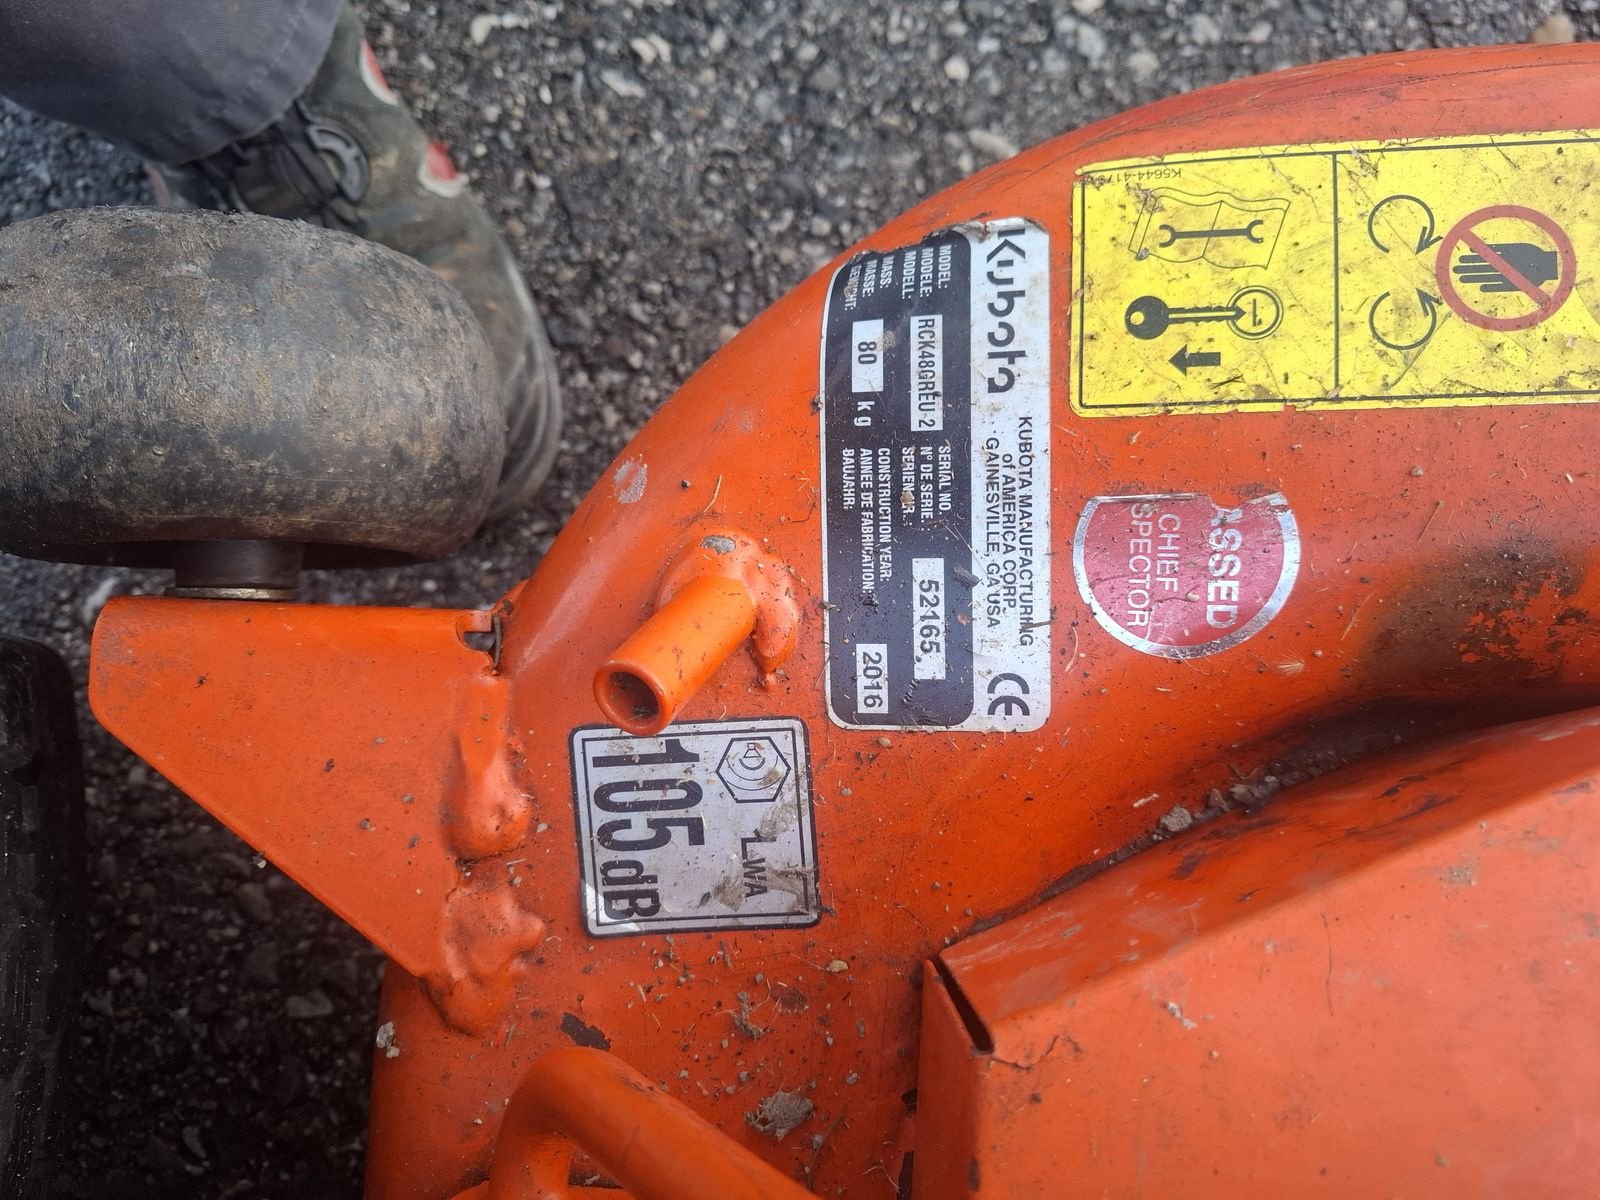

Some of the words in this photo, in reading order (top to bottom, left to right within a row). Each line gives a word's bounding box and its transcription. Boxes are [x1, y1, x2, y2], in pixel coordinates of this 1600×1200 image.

[843, 266, 861, 311] GEWCHT:
[862, 260, 877, 298] MASSE:
[878, 256, 894, 288] MASS:
[901, 251, 916, 300] MODELL:
[918, 248, 934, 298] MODELE:
[937, 245, 951, 289] MODEL:
[986, 228, 1027, 393] Kubota
[856, 341, 877, 365] 80
[859, 448, 873, 489] ANNEE
[919, 464, 933, 480] DE
[938, 446, 951, 490] SERIAL
[1001, 454, 1015, 469] of
[1018, 417, 1032, 489] KUBOTA
[841, 449, 854, 510] BAUJAHR:
[860, 492, 873, 508] DE
[877, 448, 891, 542] CONSTRUCTION
[901, 447, 915, 518] SERIENR.
[938, 493, 951, 515] NO.
[983, 437, 1000, 557] GAINESVILLE,
[1001, 475, 1016, 554] AMERICA
[860, 512, 874, 594] FABRICATION:
[878, 546, 892, 582] YEAR:
[986, 563, 1000, 587] GA
[1018, 495, 1034, 646] MANUFACTURING
[1155, 514, 1180, 592] CHIEF
[918, 580, 940, 654] 52165
[986, 592, 1000, 628] USA
[862, 652, 883, 708] 2016
[986, 673, 1030, 716] CE
[591, 739, 705, 851] 105
[599, 860, 660, 922] dB
